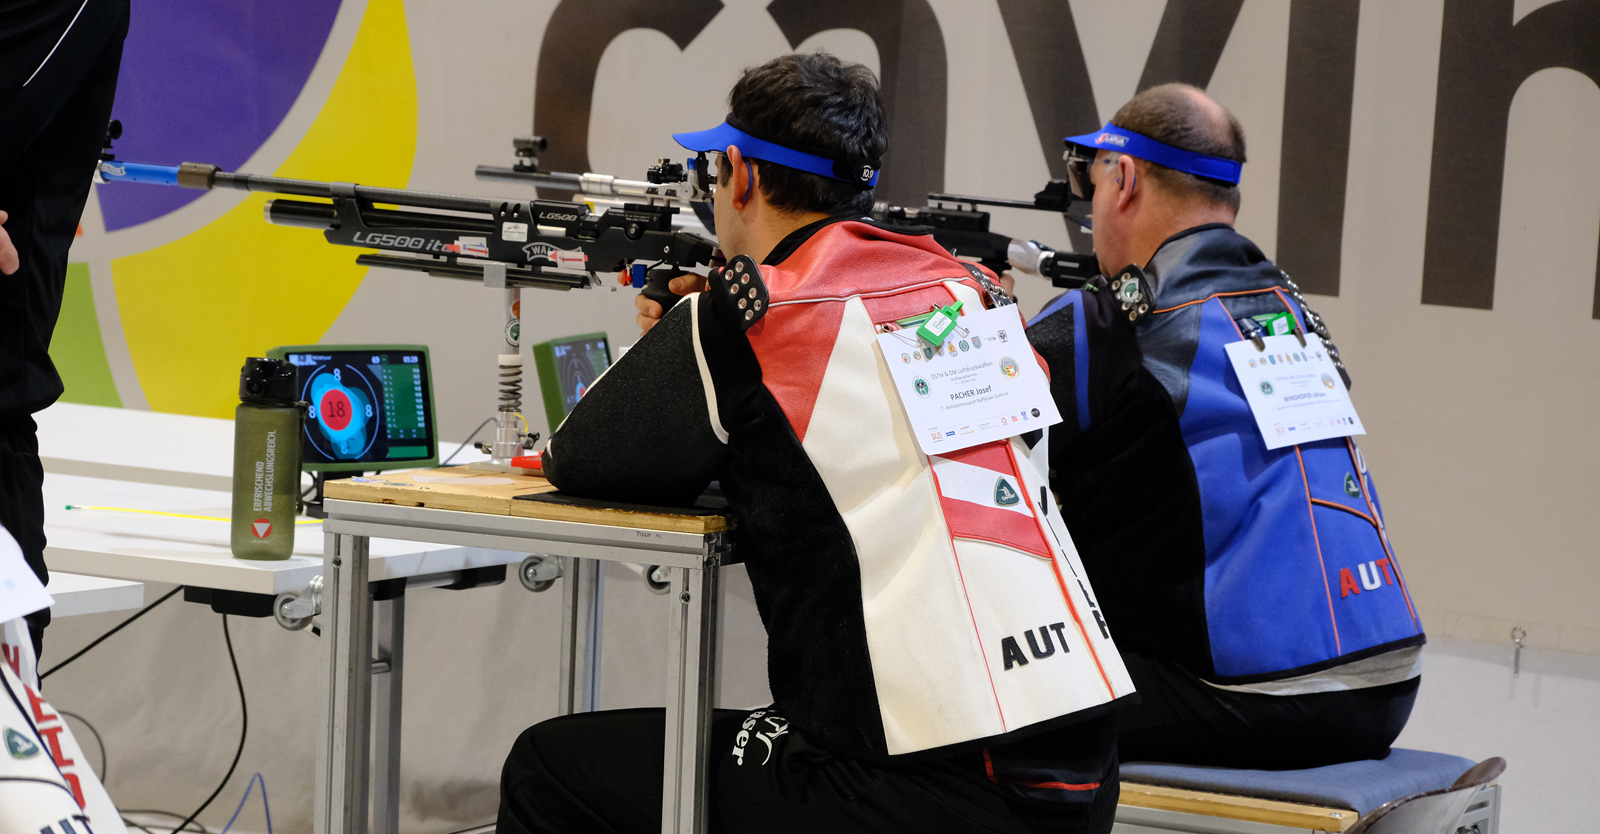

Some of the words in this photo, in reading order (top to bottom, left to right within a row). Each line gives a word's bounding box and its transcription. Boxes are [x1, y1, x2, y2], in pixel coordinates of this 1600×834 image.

[862, 168, 875, 179] 10.9
[538, 211, 578, 222] LG500
[352, 231, 425, 249] LG500
[334, 368, 341, 382] 8
[950, 389, 975, 400] PACHER
[976, 385, 992, 395] Josef
[308, 405, 316, 419] 8
[328, 401, 346, 418] 18
[365, 404, 372, 418] 8
[264, 429, 277, 512] ABWECHSLUNGSREICH.
[253, 461, 264, 511] ERFRISCHEND
[1338, 558, 1393, 598] AUT
[1000, 622, 1071, 672] AUT
[732, 710, 766, 766] aser
